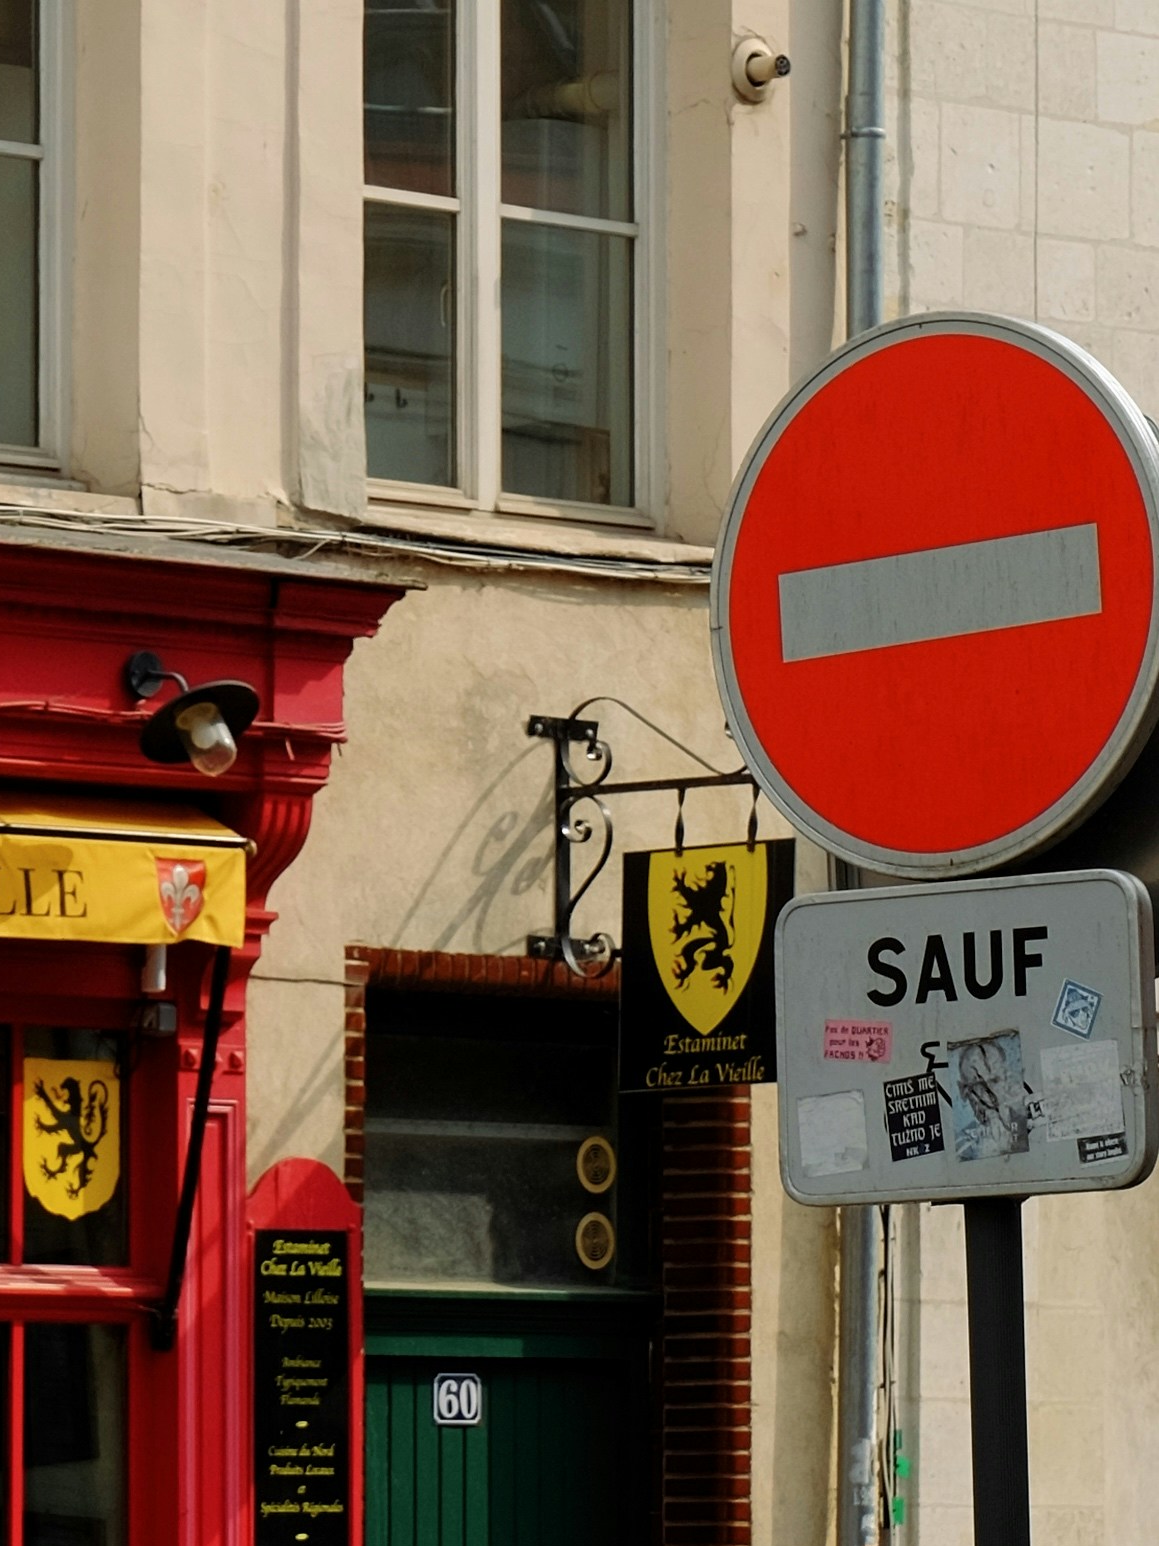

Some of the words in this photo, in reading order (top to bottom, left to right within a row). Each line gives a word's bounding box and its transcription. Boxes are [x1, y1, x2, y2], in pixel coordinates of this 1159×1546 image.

[865, 926, 1048, 1007] SAUF
[851, 1026, 889, 1036] QUARTIER
[663, 1031, 747, 1055] Estaminet
[824, 1050, 856, 1060] FACHOS
[645, 1061, 683, 1087] Chez
[687, 1064, 710, 1085] La
[715, 1055, 765, 1082] Vieille
[902, 1110, 926, 1128] KAD
[272, 1239, 331, 1254] Estaminet
[260, 1257, 288, 1276] Chez
[289, 1261, 306, 1276] La
[307, 1258, 342, 1276] Vieille
[262, 1290, 301, 1304] Maison
[304, 1288, 339, 1304] Lilloise
[270, 1313, 305, 1334] Depuis
[307, 1317, 333, 1330] 2003
[275, 1373, 328, 1391] Typiquement
[439, 1379, 477, 1418] 60
[268, 1445, 298, 1456] Cuisine
[299, 1443, 310, 1456] du
[311, 1443, 335, 1456] Nord
[269, 1462, 303, 1475] Produits
